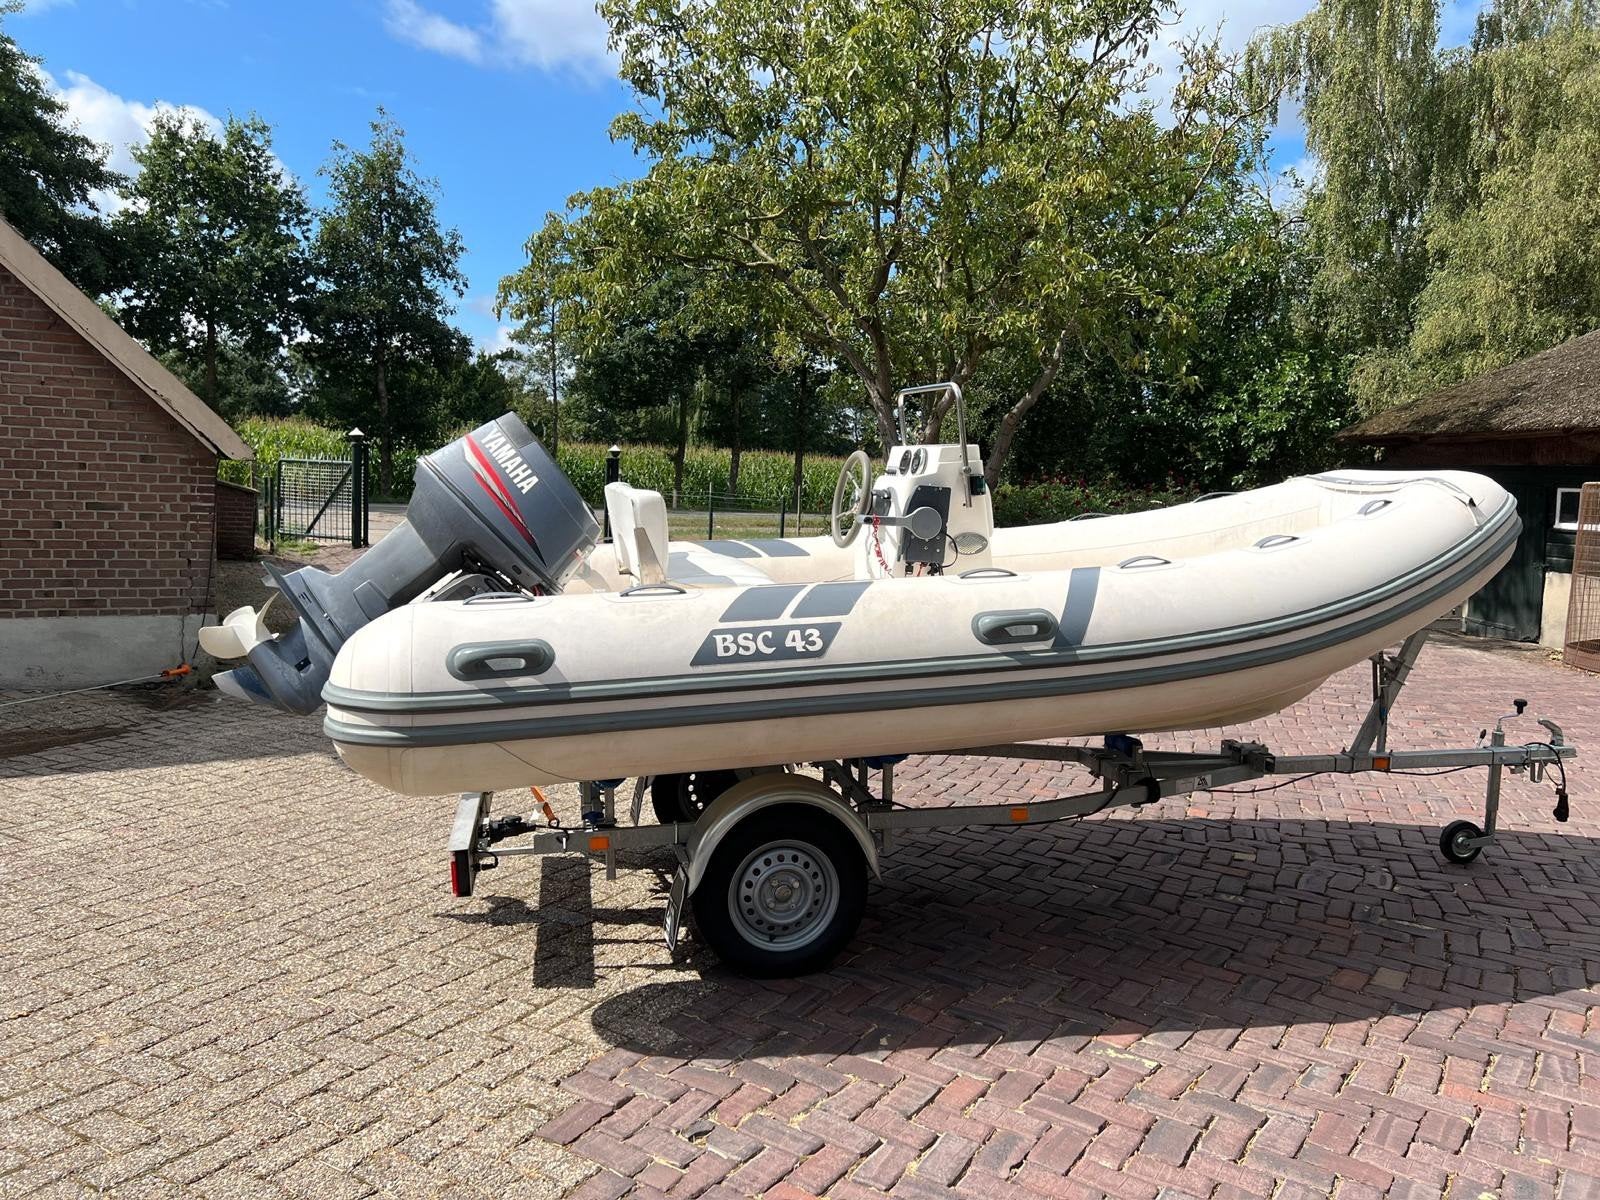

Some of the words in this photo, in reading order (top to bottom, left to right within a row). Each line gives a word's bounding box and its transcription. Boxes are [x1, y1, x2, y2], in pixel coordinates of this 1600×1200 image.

[481, 427, 539, 494] YAMAHA
[713, 631, 776, 657] BSC
[785, 628, 824, 652] 43
